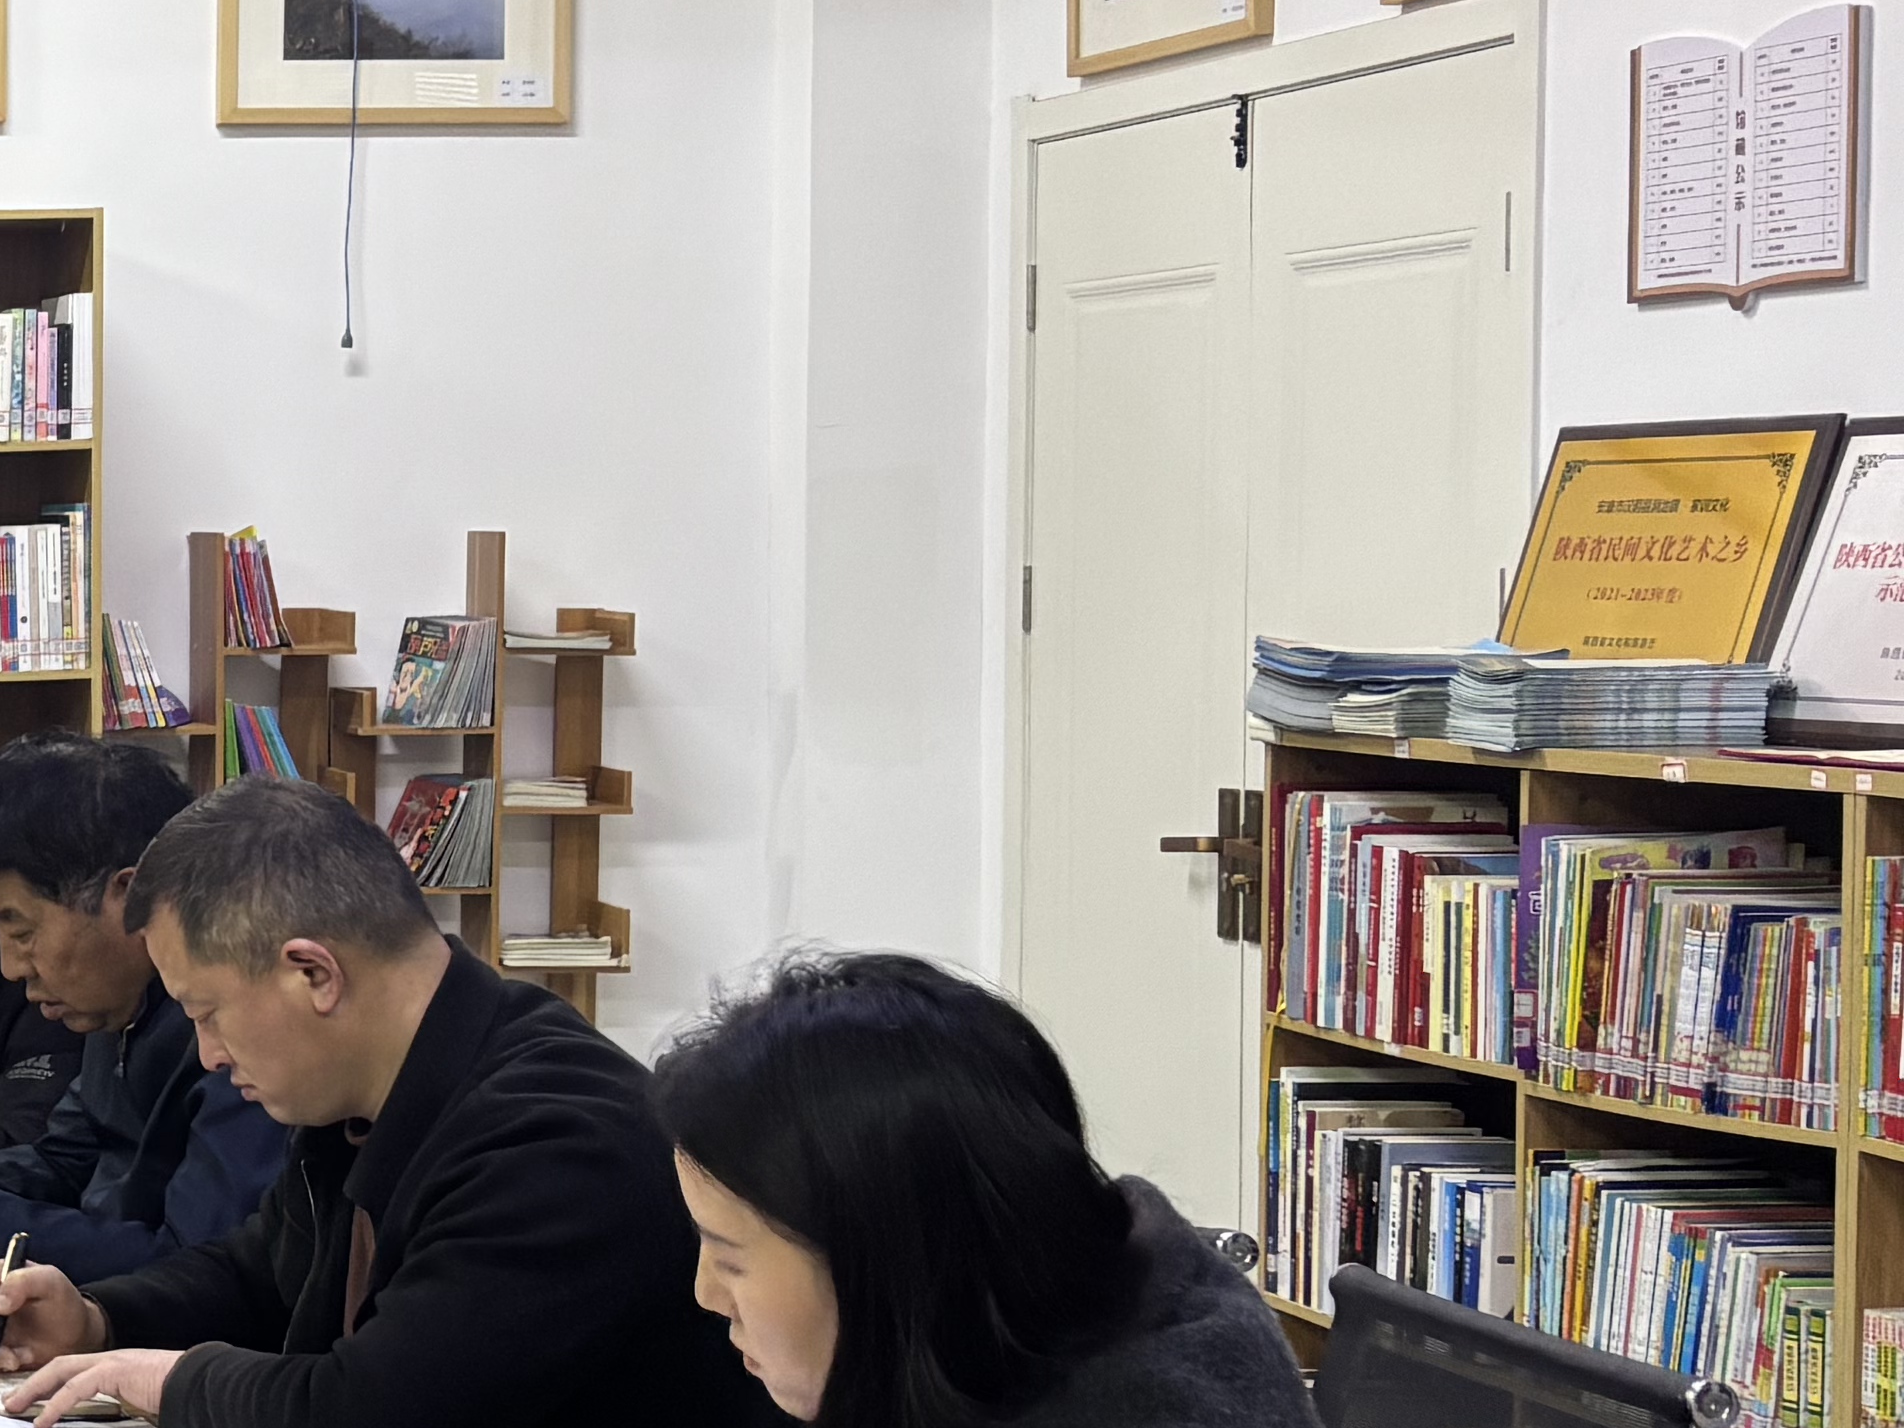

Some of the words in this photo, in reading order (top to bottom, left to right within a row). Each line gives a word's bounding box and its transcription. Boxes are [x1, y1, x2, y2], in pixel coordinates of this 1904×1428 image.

[1553, 535, 1748, 562] 陕西省民间文化艺术之乡
